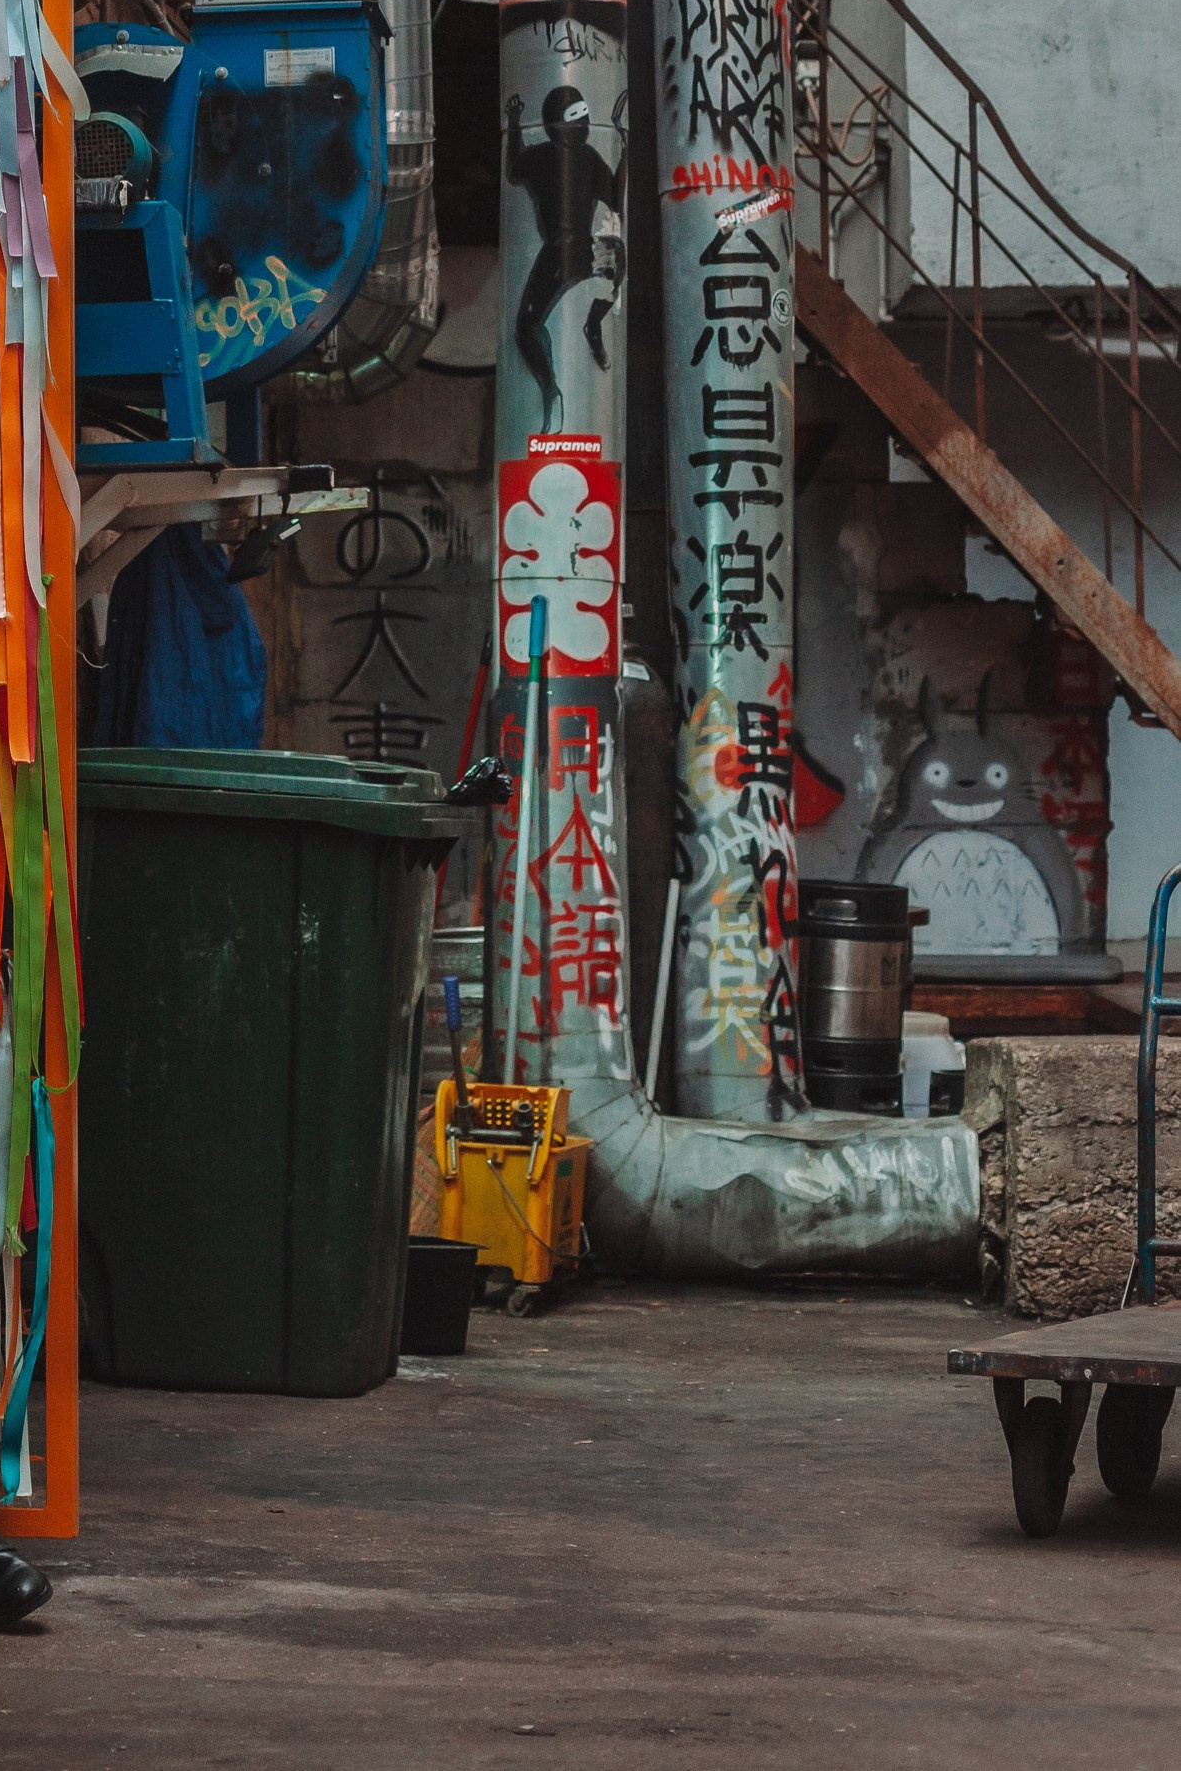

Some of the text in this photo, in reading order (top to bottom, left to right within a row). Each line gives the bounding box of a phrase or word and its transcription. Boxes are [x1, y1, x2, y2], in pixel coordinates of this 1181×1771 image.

[718, 193, 780, 227] Supramen
[529, 437, 601, 455] Supramen
[527, 705, 620, 1028] 日本語
